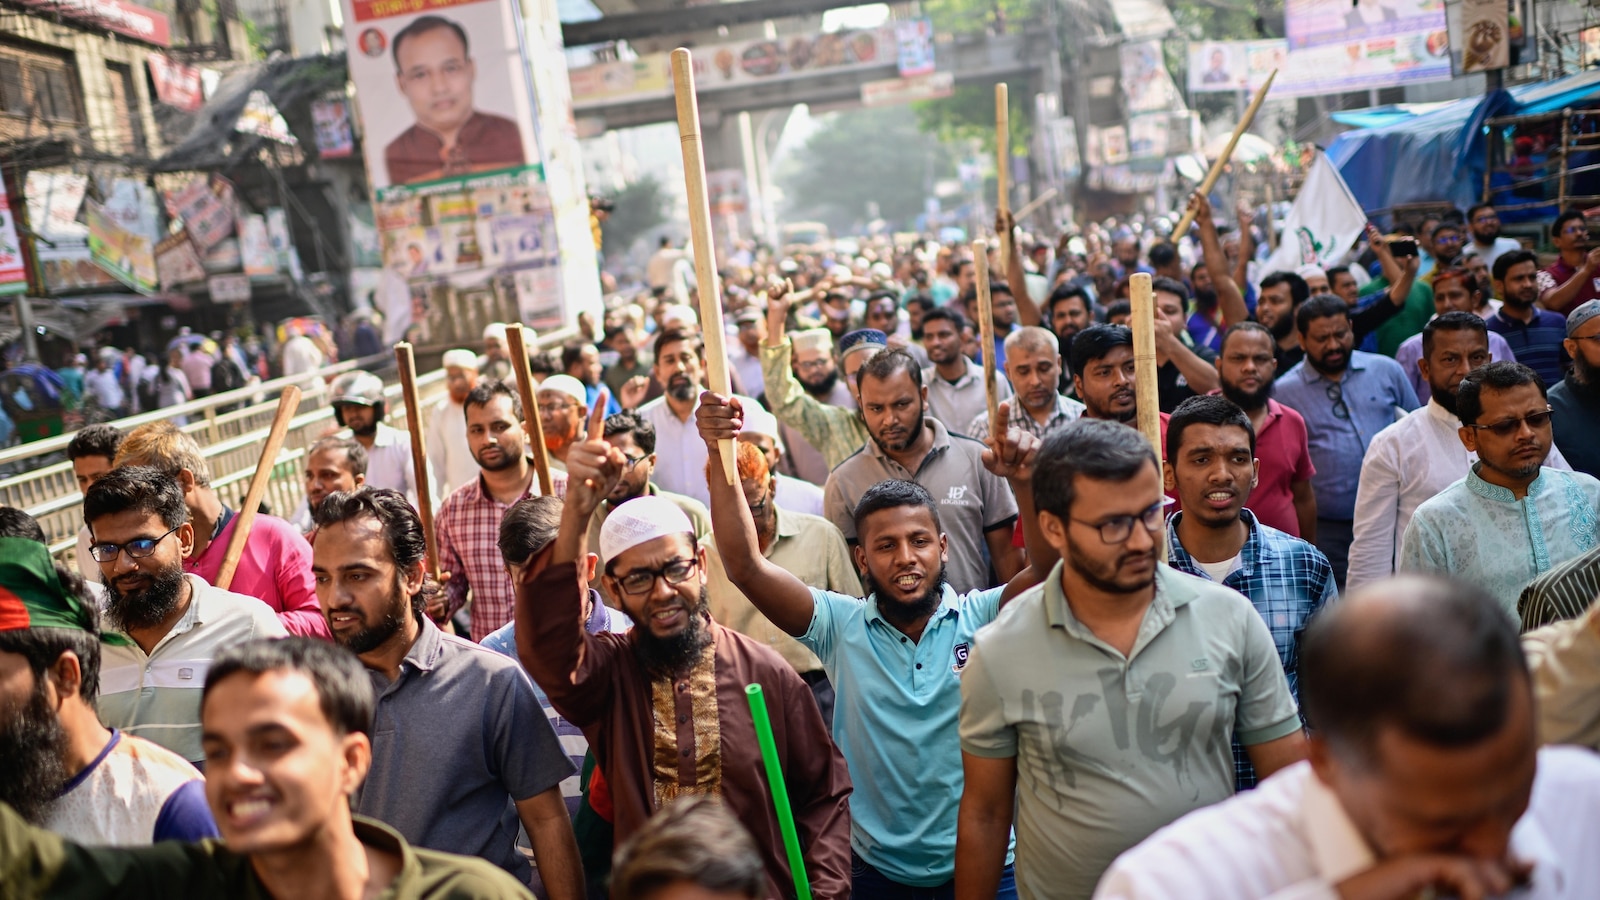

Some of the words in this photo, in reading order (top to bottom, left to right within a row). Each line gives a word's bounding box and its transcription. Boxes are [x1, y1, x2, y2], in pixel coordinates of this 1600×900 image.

[947, 485, 967, 500] ID
[941, 498, 969, 506] LOGISTICS
[957, 648, 968, 660] G
